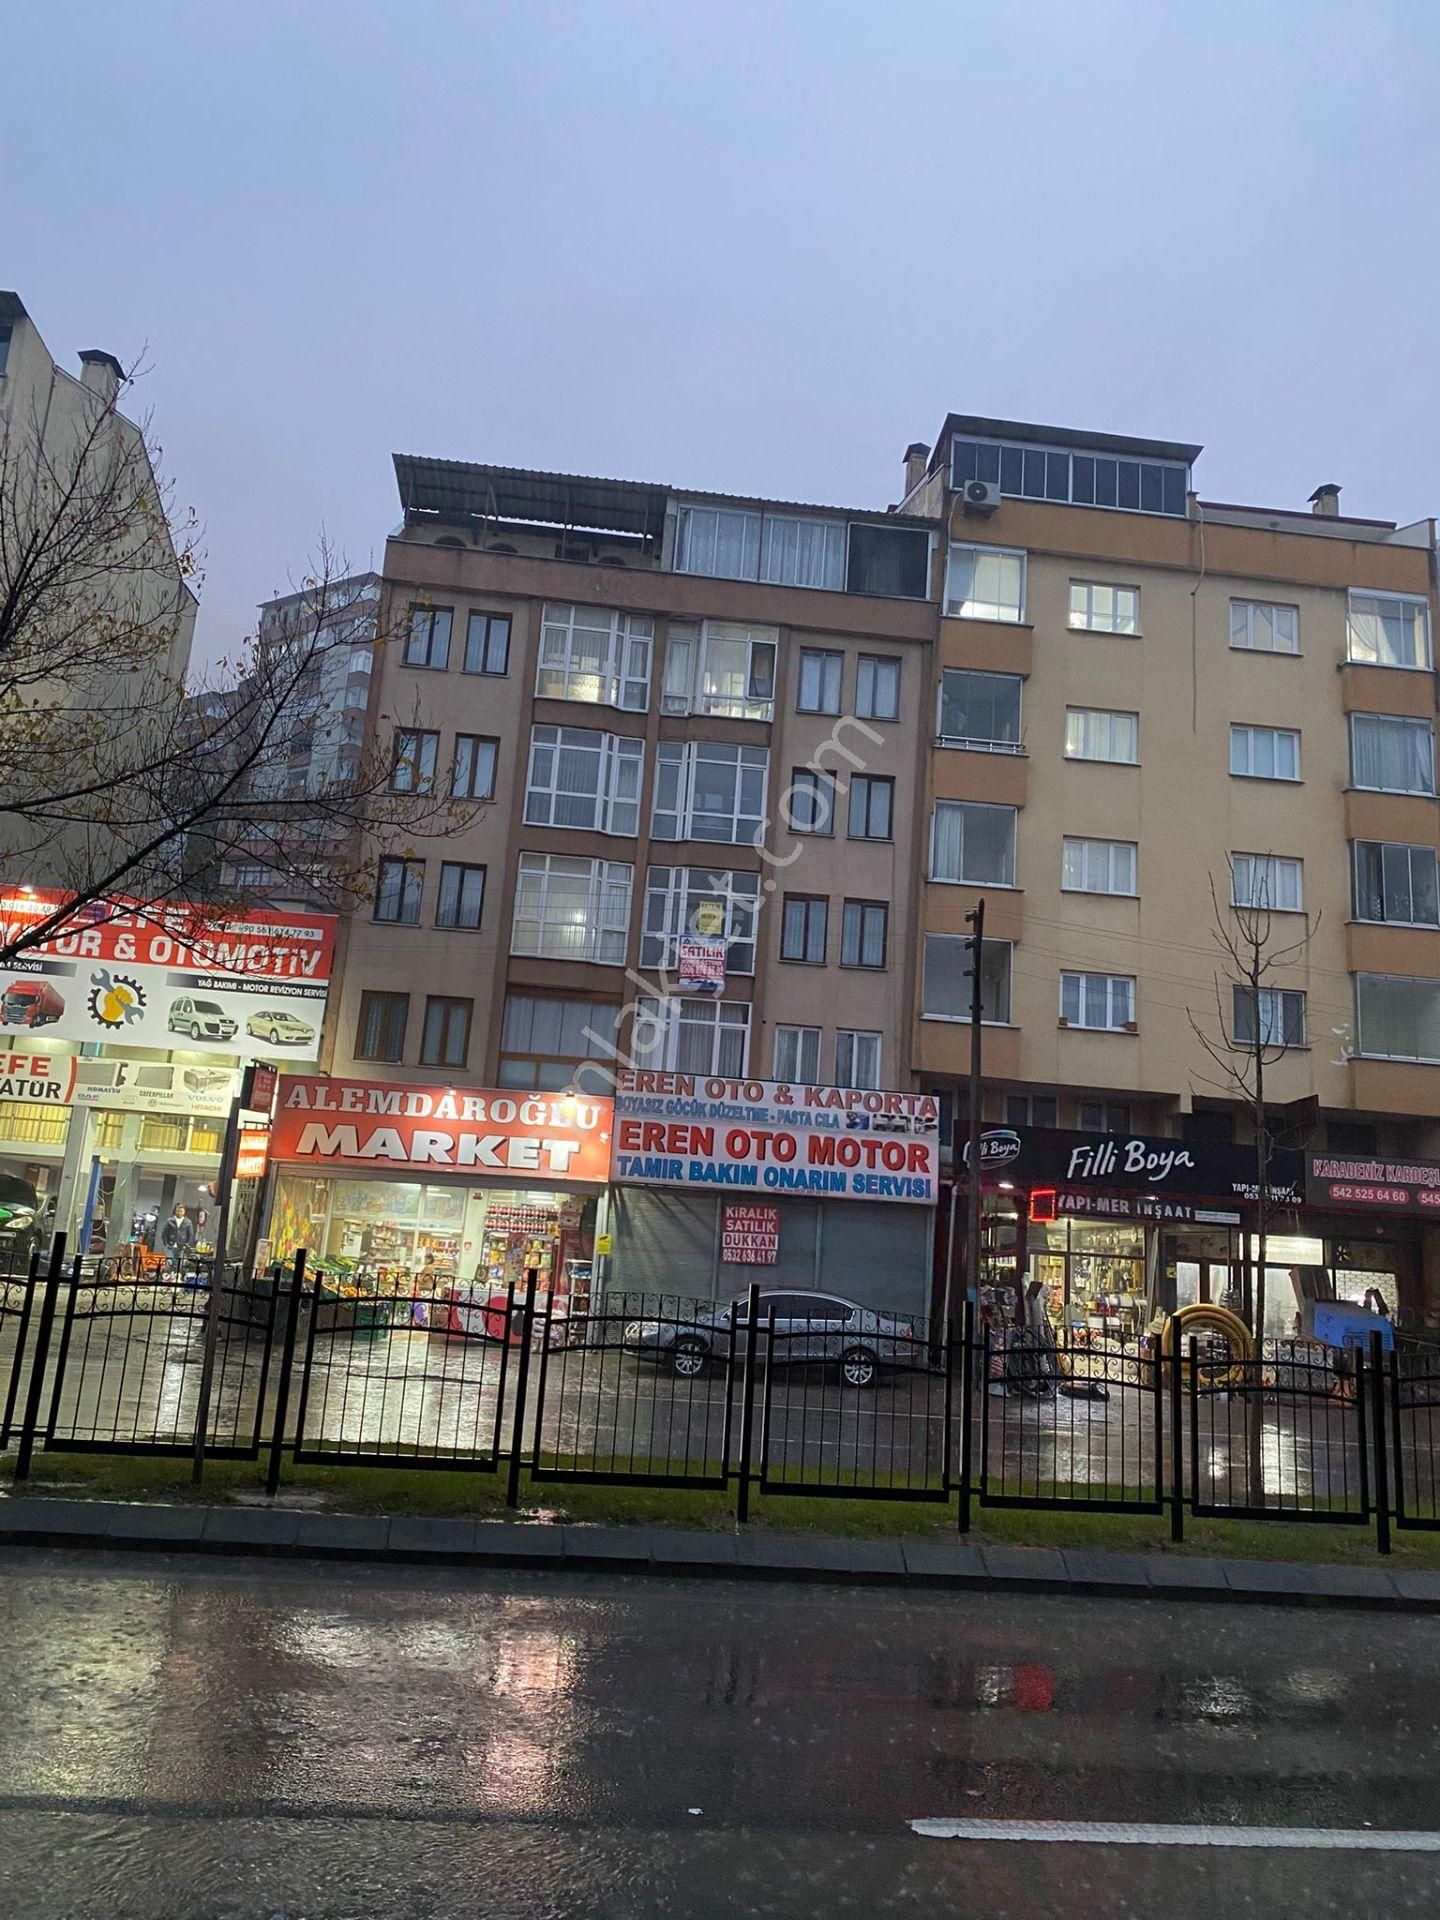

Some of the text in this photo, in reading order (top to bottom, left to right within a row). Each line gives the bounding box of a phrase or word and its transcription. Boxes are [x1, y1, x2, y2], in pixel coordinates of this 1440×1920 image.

[114, 933, 137, 960] &
[242, 983, 269, 992] MOTOR
[139, 1090, 174, 1099] CATERPILLAR
[188, 1094, 224, 1103] VOLVO
[616, 1069, 939, 1117] EREN OTO & KAPORTA
[191, 1103, 222, 1112] HITACHI
[284, 1085, 602, 1129] ALEMDAROĞLU
[777, 1109, 812, 1127] PASTA
[296, 1123, 581, 1172] MARKET
[618, 1120, 931, 1174] EREN OTO MOTOR
[990, 1141, 1018, 1156] Boya
[1067, 1139, 1195, 1182] Filli Boya
[617, 1155, 684, 1180] TAMIR
[689, 1160, 758, 1186] BAKIM
[763, 1166, 847, 1192] ONARIM
[1313, 1158, 1385, 1182] KARADENİZ
[1333, 1187, 1352, 1198] 542
[1355, 1188, 1374, 1199] 525
[1377, 1190, 1390, 1200] 64
[1392, 1191, 1406, 1202] 60
[1058, 1194, 1130, 1214] YAPI-MER
[726, 1219, 776, 1233] SATILIK
[724, 1233, 777, 1248] DÜKKAN
[723, 1248, 777, 1264] 0532 636 41 97
